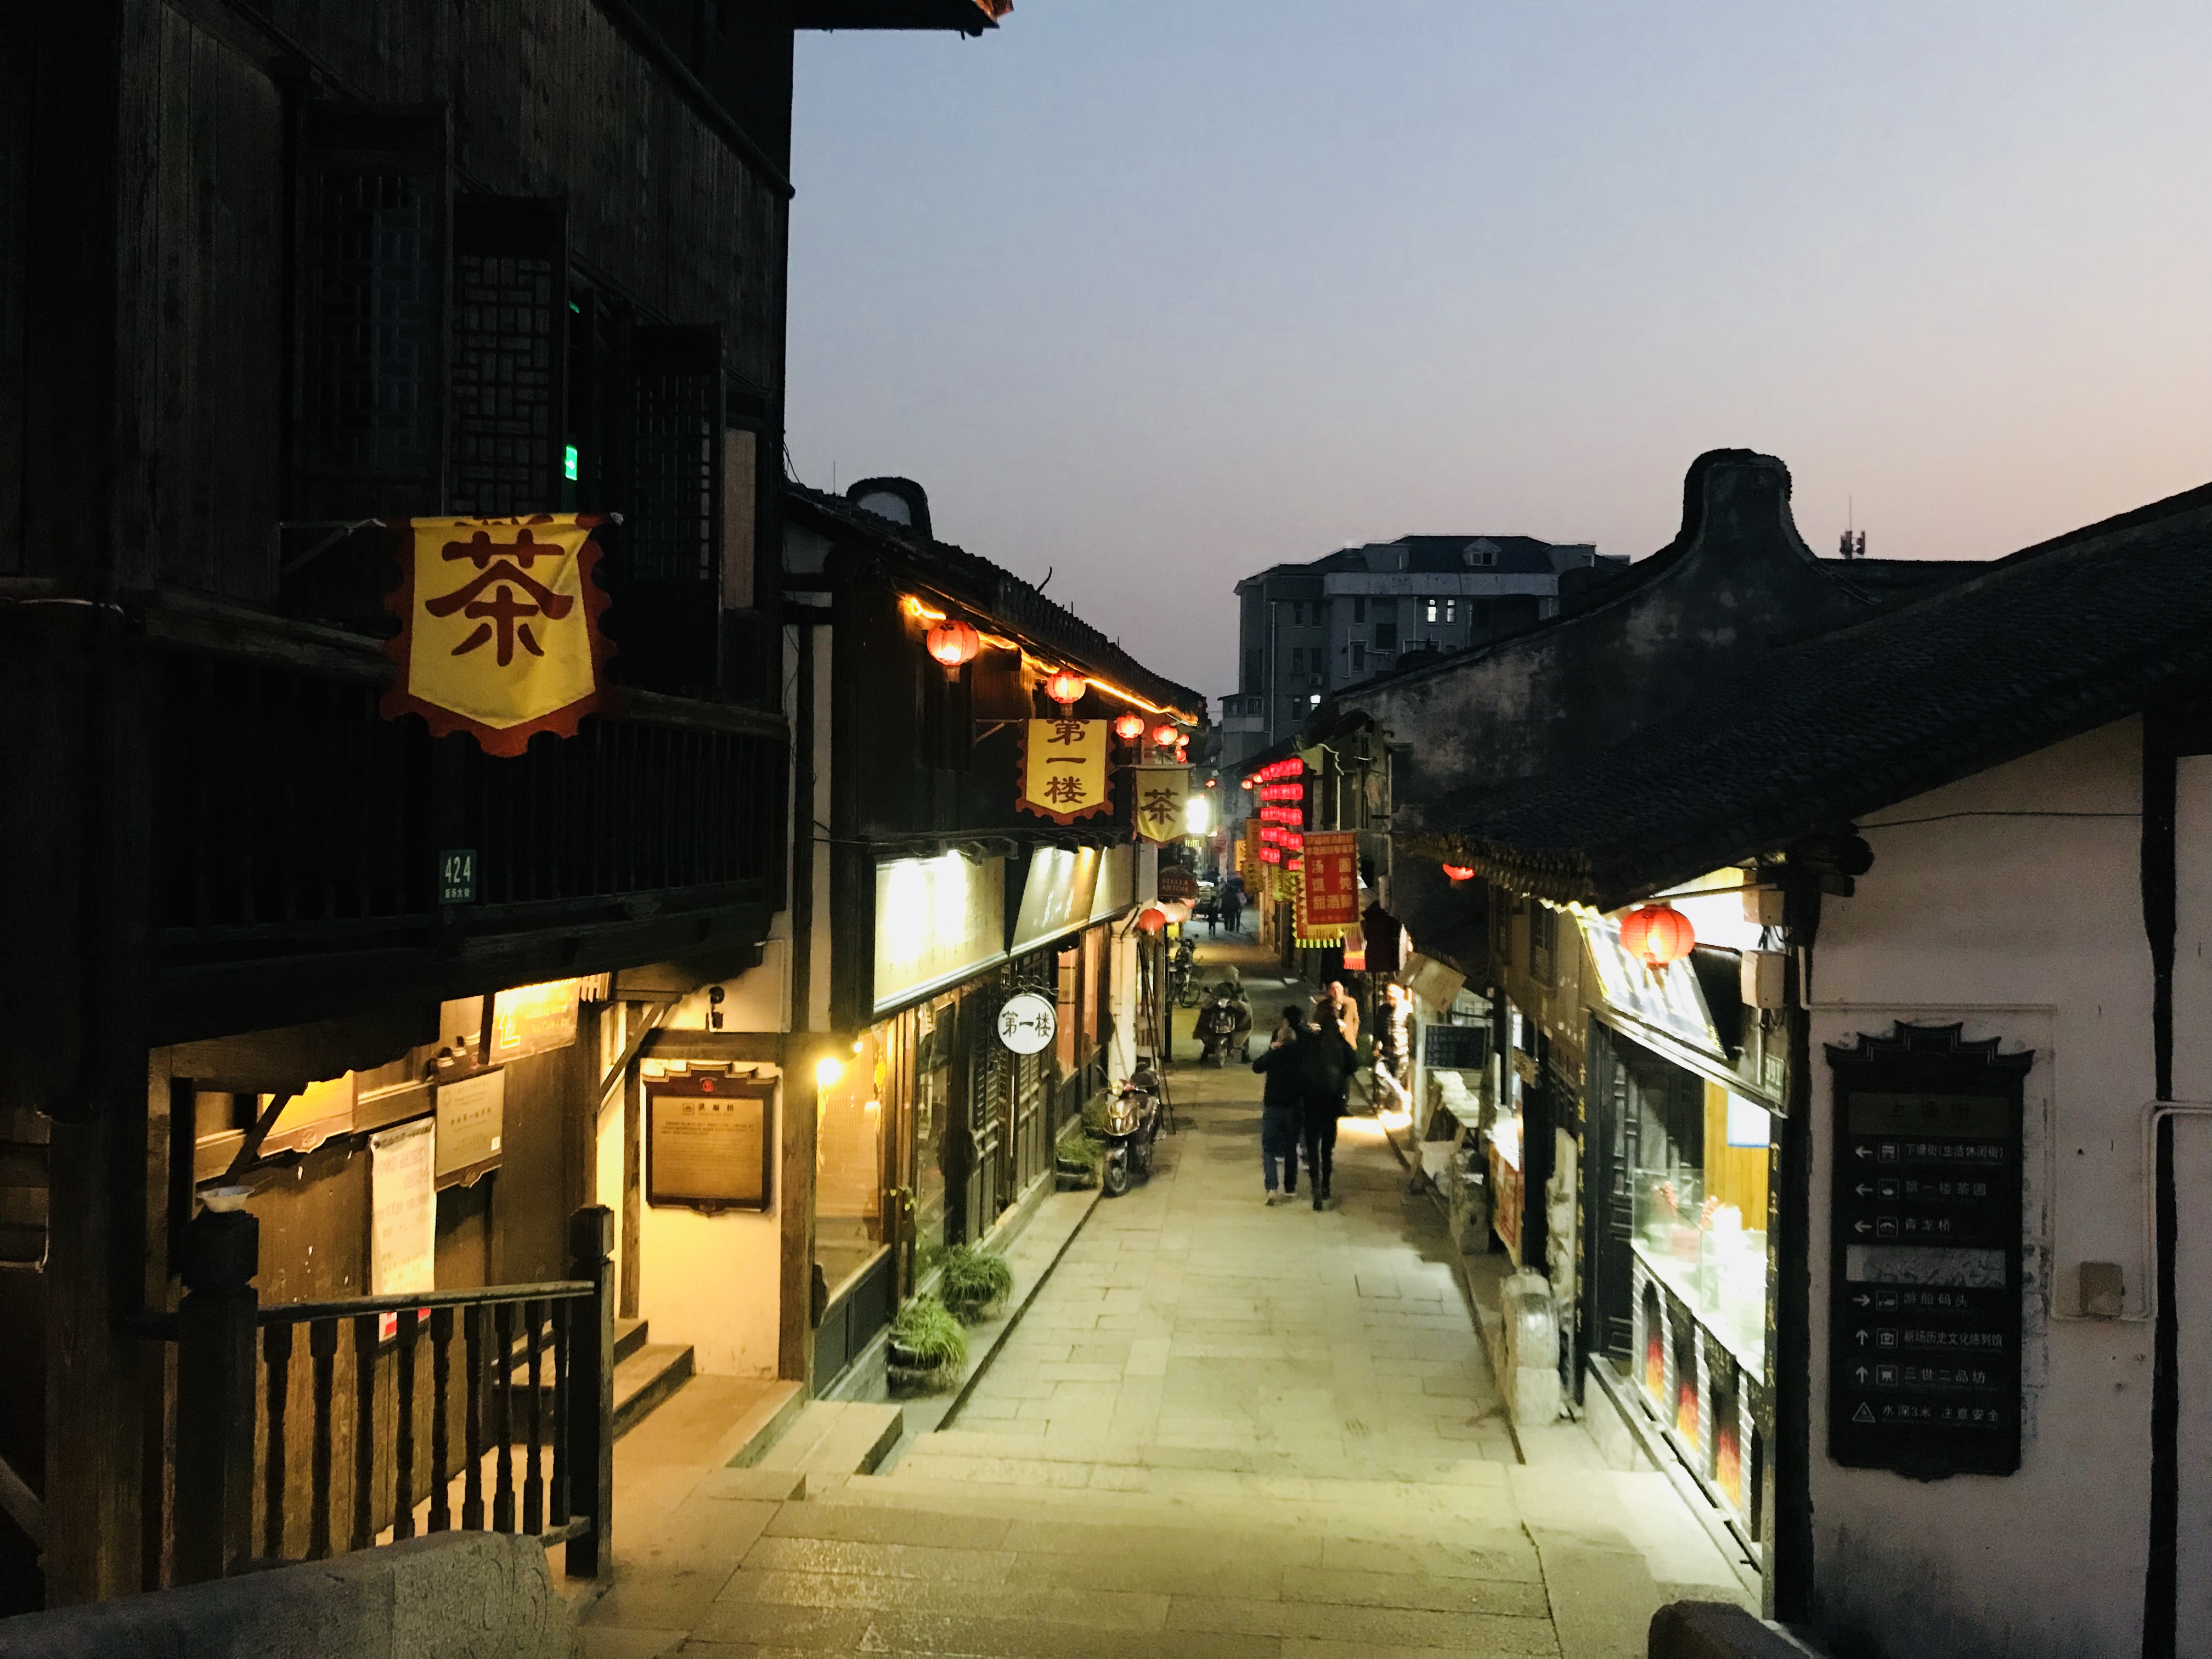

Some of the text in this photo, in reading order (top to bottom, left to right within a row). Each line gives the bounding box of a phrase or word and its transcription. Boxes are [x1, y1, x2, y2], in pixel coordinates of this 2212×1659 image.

[425, 528, 574, 667] 茶
[1044, 719, 1087, 804] 第一楼
[1140, 788, 1183, 826] 茶
[445, 856, 471, 883] 424
[1002, 1011, 1051, 1038] 第一楼
[1765, 1057, 1781, 1086] 391
[1904, 1291, 1968, 1308] 游船码头
